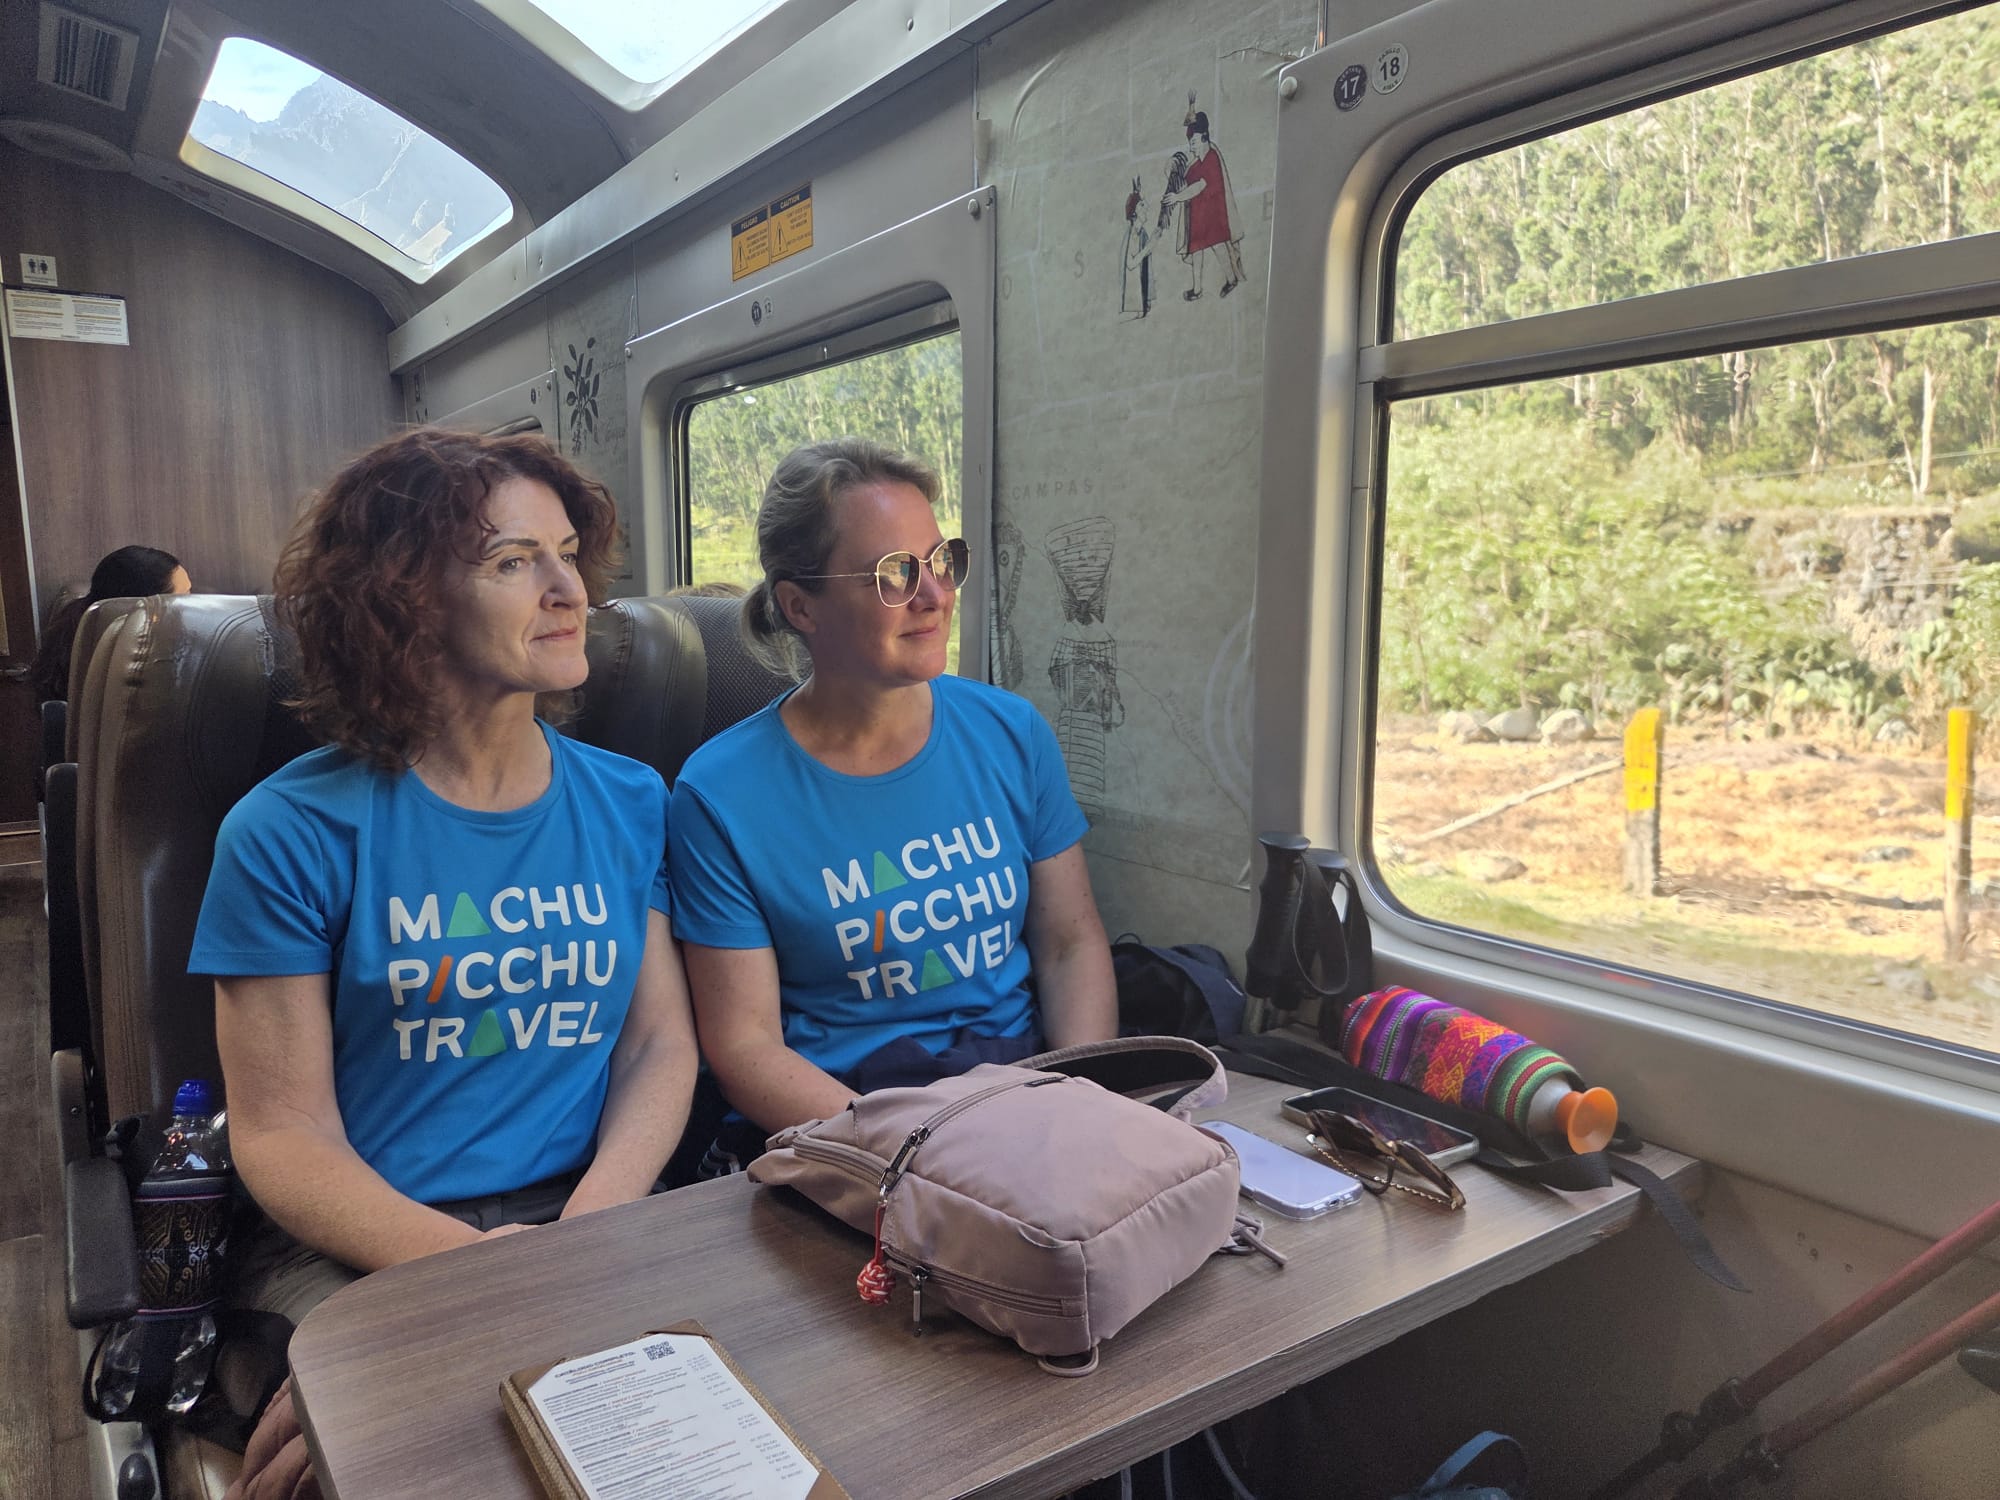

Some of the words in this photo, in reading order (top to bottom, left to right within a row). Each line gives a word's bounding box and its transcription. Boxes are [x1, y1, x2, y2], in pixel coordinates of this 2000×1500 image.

[1340, 75, 1360, 99] 17
[1379, 56, 1401, 81] 18
[740, 216, 758, 229] PELIGRO
[780, 194, 800, 209] CAUTION
[764, 302, 772, 313] 12
[1012, 478, 1094, 501] CAMPAS
[822, 816, 1001, 909] MACHU
[388, 883, 608, 944] MACHU
[835, 866, 1017, 962] PICCHU
[388, 940, 617, 1006] PICCHU
[847, 920, 1015, 1000] TRAVEL
[392, 1001, 604, 1062] TRAVEL
